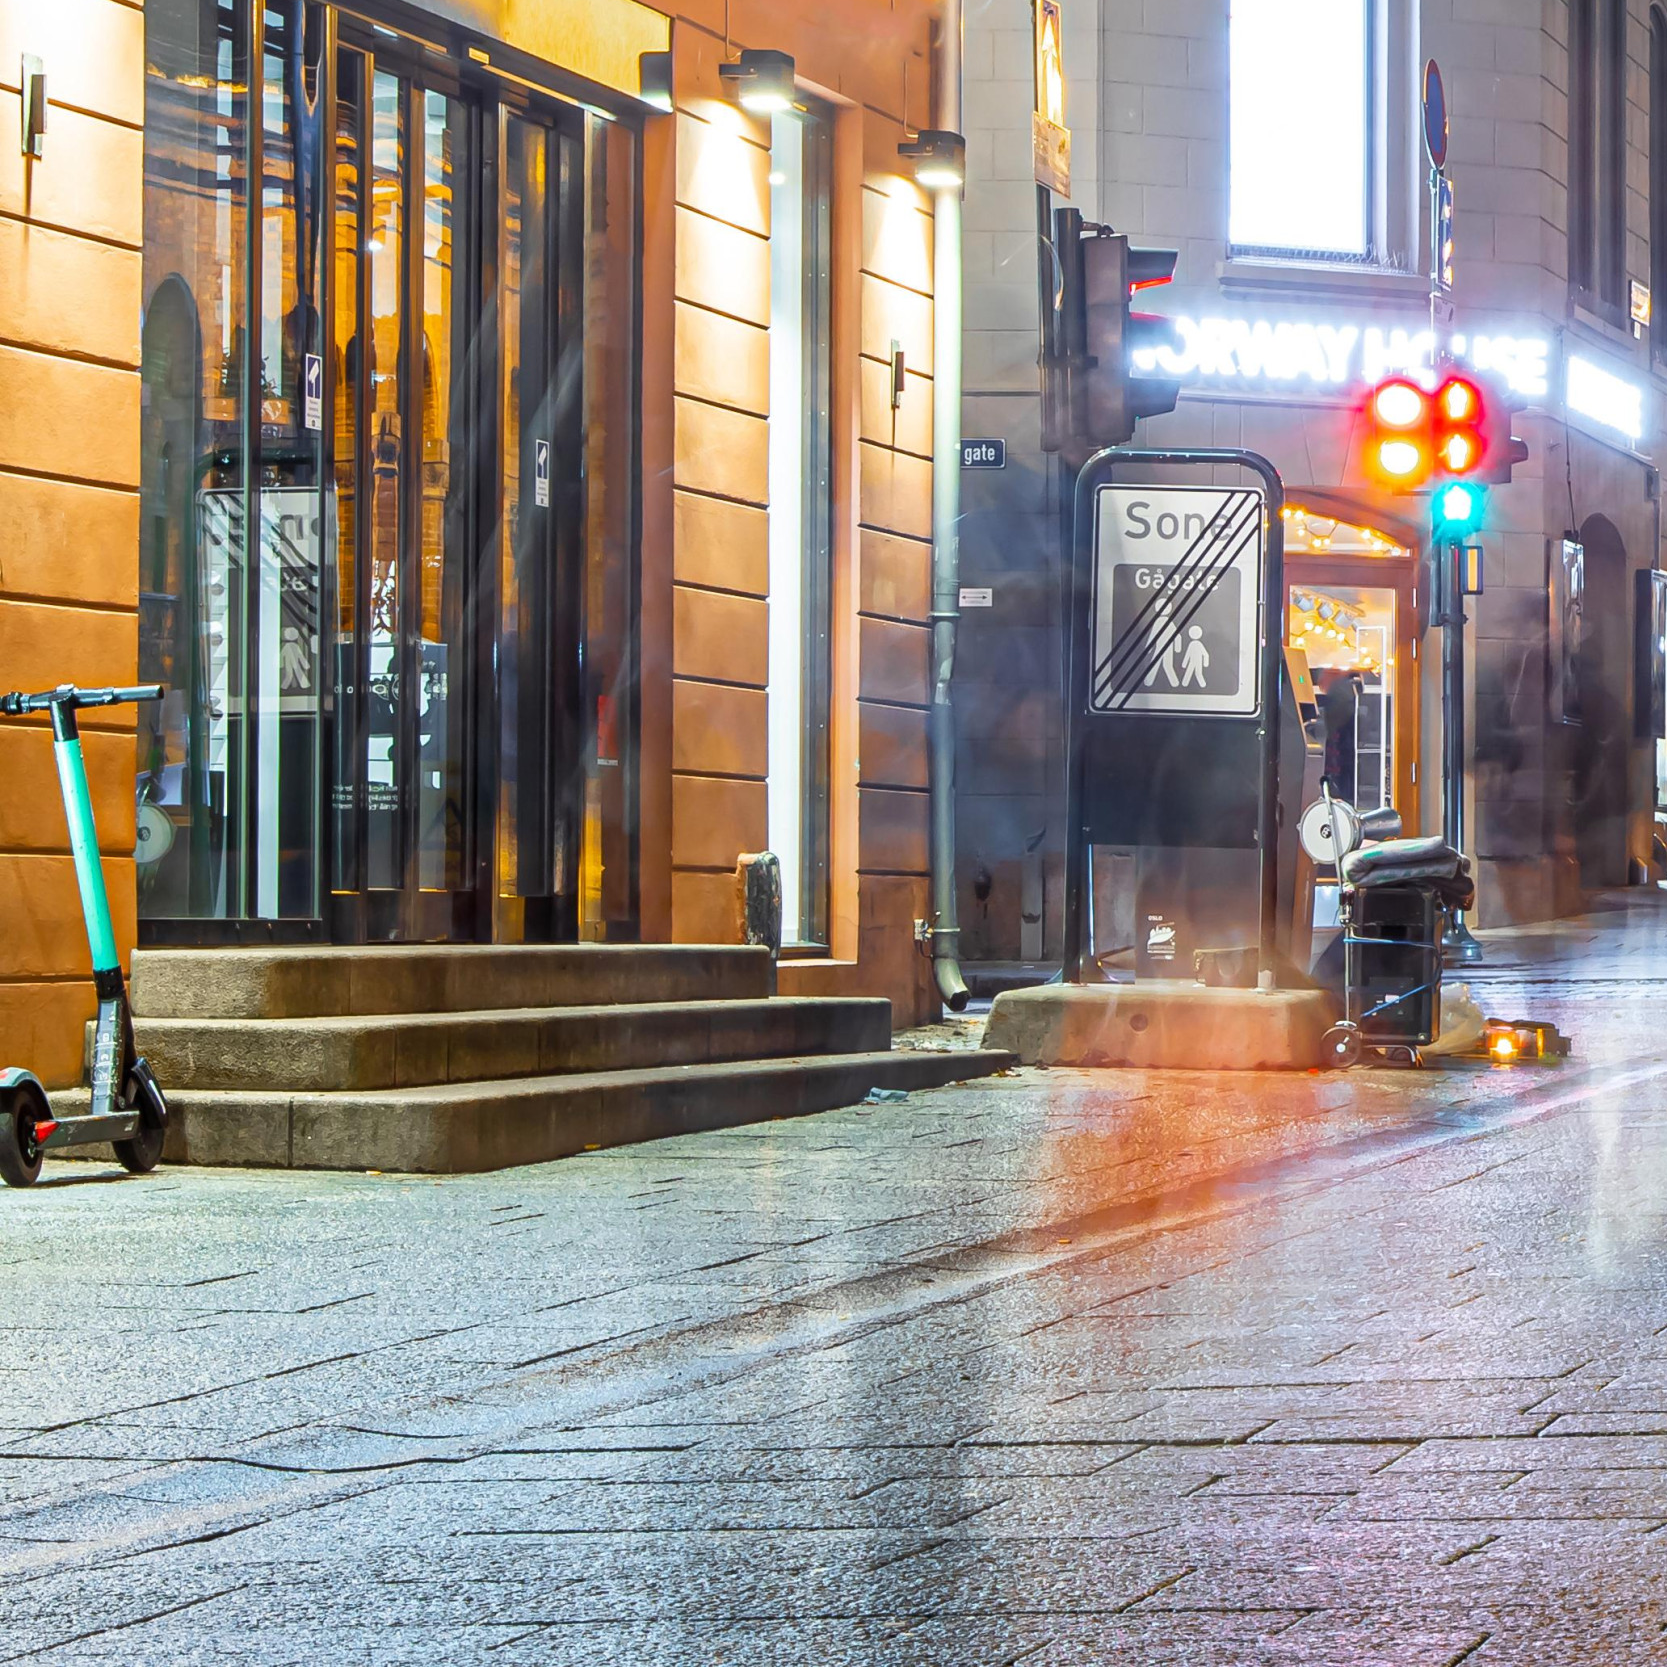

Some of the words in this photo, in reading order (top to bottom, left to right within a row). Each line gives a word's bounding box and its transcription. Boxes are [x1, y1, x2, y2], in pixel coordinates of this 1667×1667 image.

[964, 443, 996, 465] gate
[1124, 500, 1233, 542] Sone
[1135, 567, 1220, 595] Gågate
